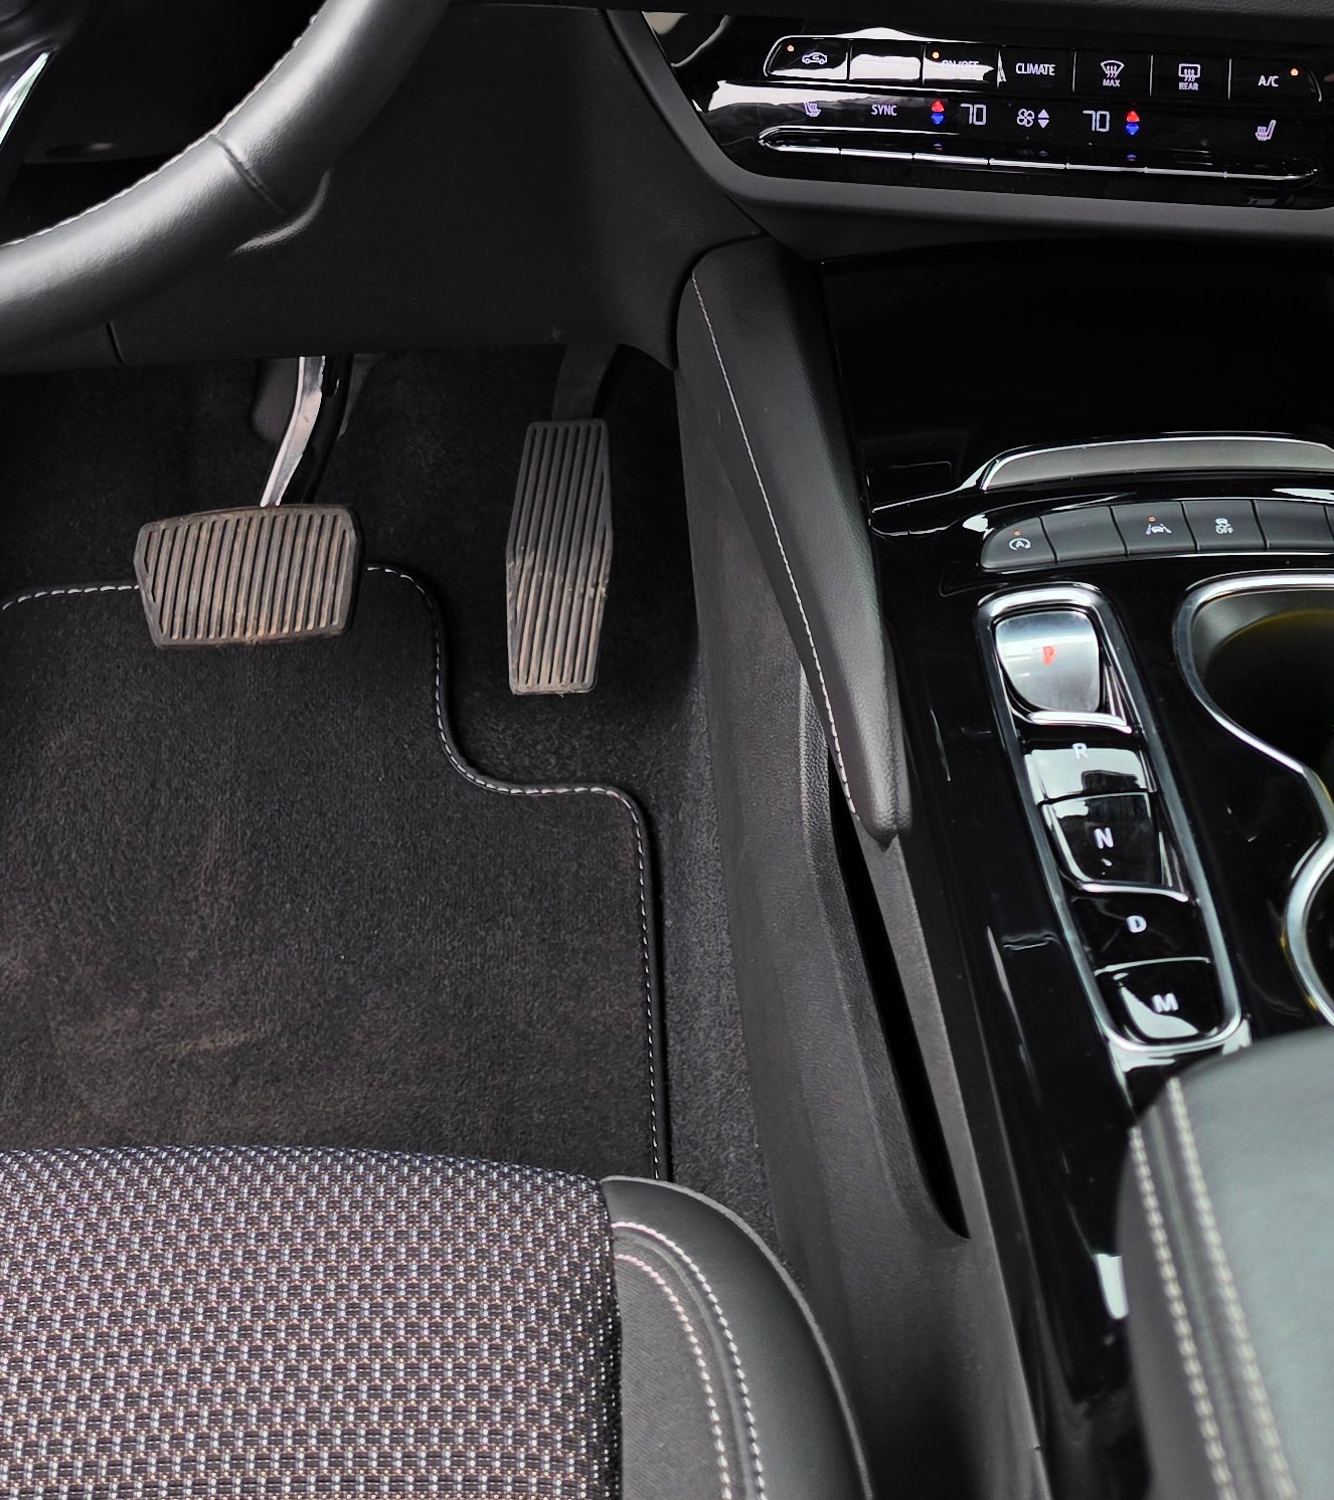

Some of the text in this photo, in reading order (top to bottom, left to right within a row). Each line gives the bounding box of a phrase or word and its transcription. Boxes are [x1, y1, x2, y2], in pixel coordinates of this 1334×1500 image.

[1016, 63, 1056, 76] CLIMATE
[1102, 78, 1121, 88] MAX
[1178, 82, 1199, 91] REAR
[1258, 75, 1279, 88] A/C
[871, 104, 898, 116] SYNC
[961, 104, 987, 126] 70
[1082, 110, 1110, 132] 70
[1042, 646, 1056, 665] P
[1072, 743, 1090, 759] R
[1093, 826, 1114, 849] N
[1126, 915, 1147, 934] D
[1152, 993, 1179, 1013] M
